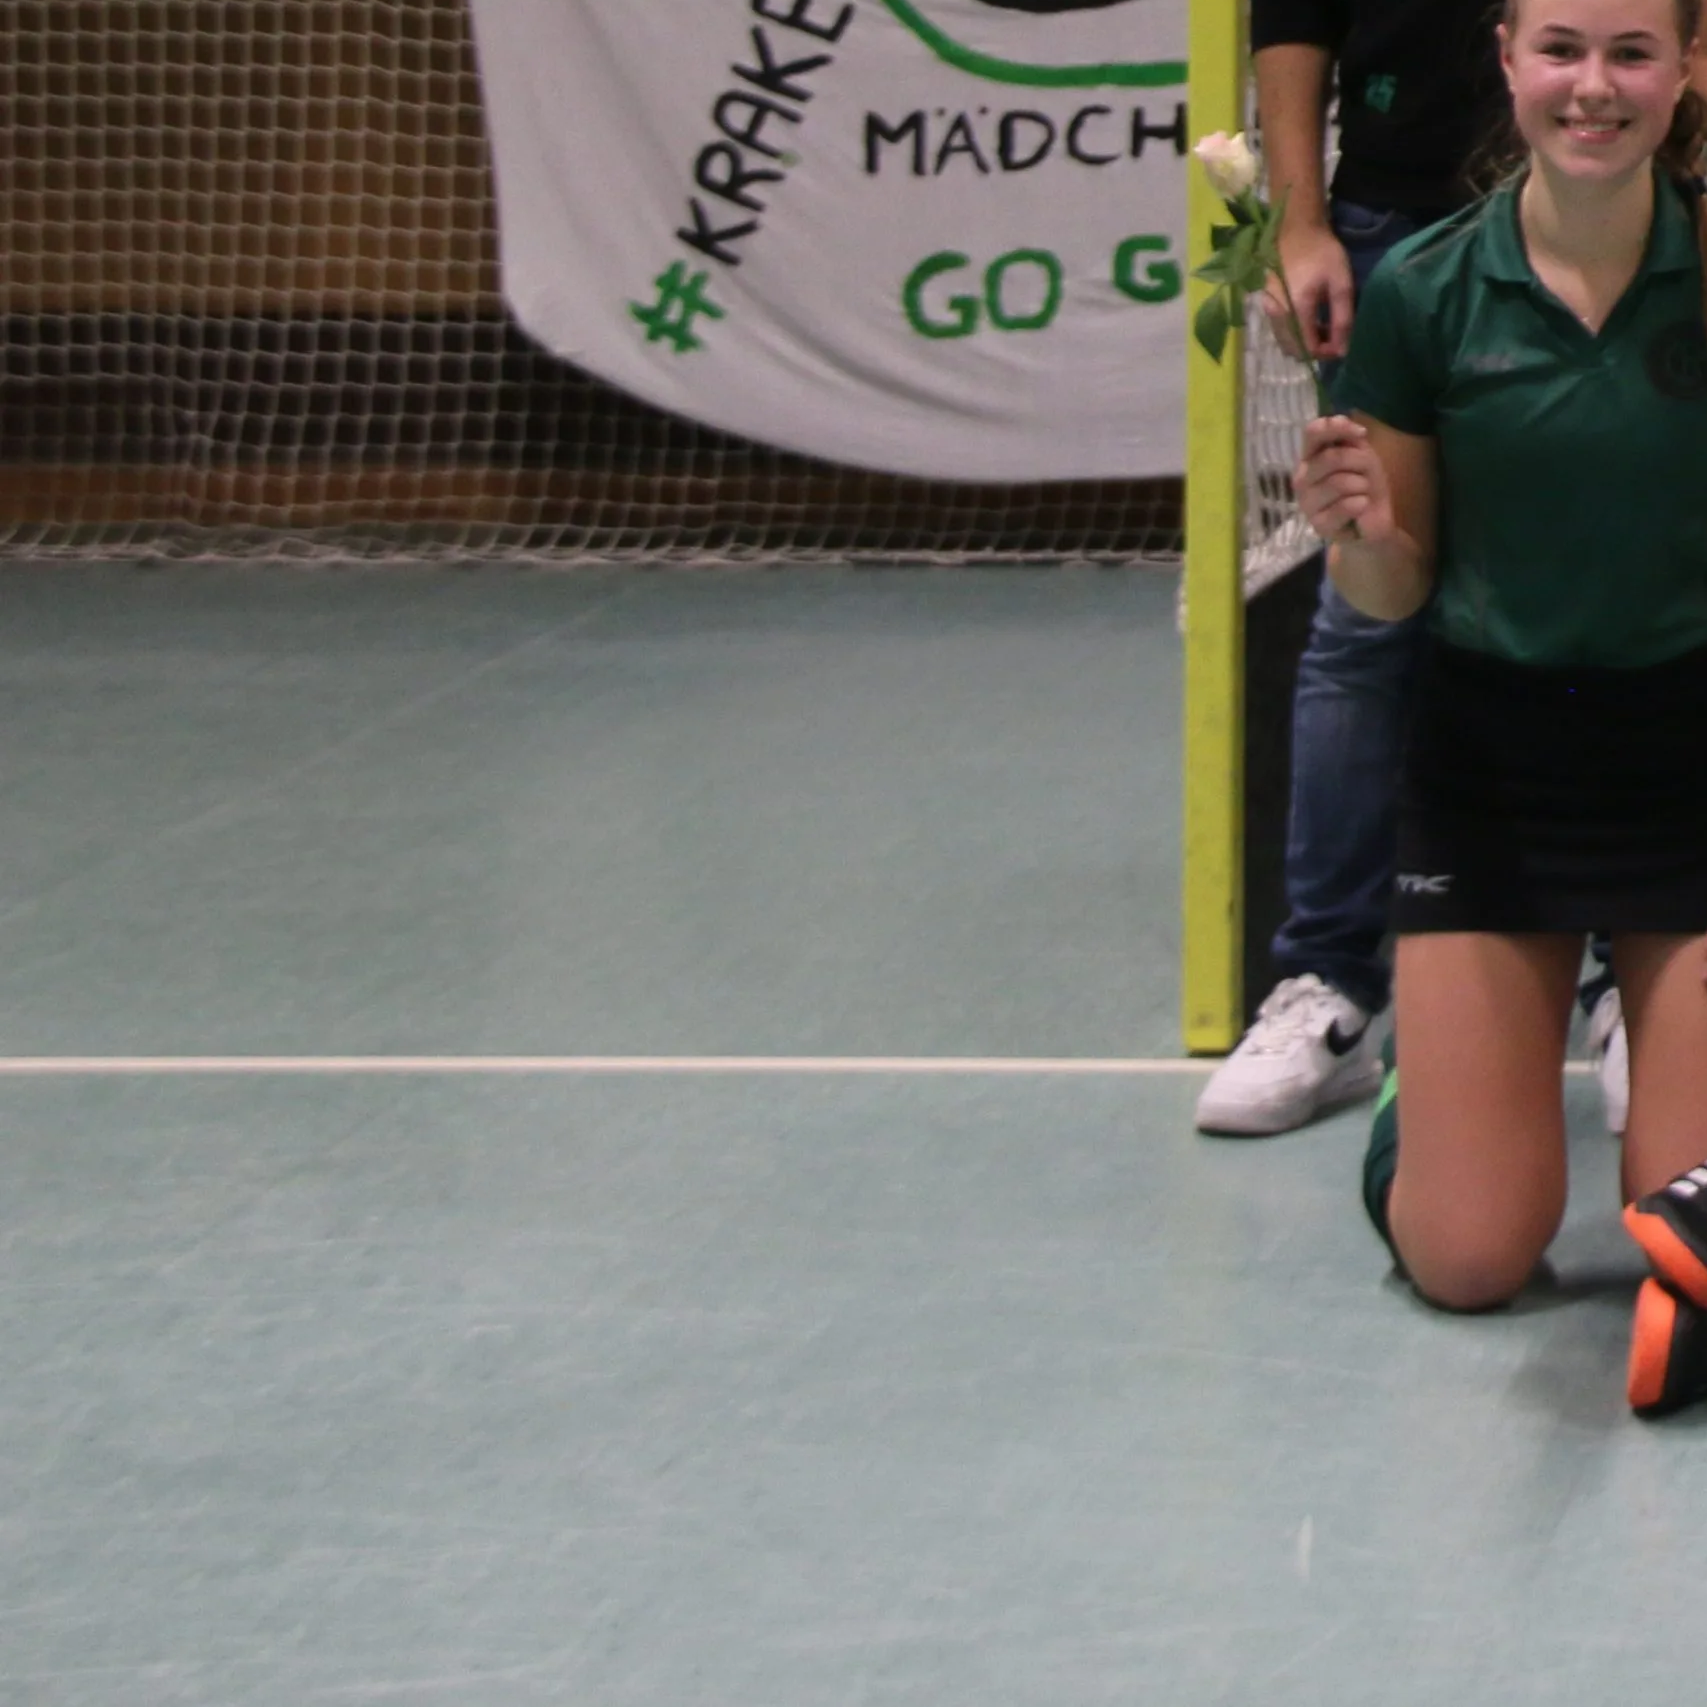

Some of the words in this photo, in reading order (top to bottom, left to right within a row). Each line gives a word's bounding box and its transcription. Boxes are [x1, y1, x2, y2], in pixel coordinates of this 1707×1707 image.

[864, 102, 1187, 176] MÄDCH
[903, 249, 1063, 341] GO
[1113, 234, 1184, 305] G
